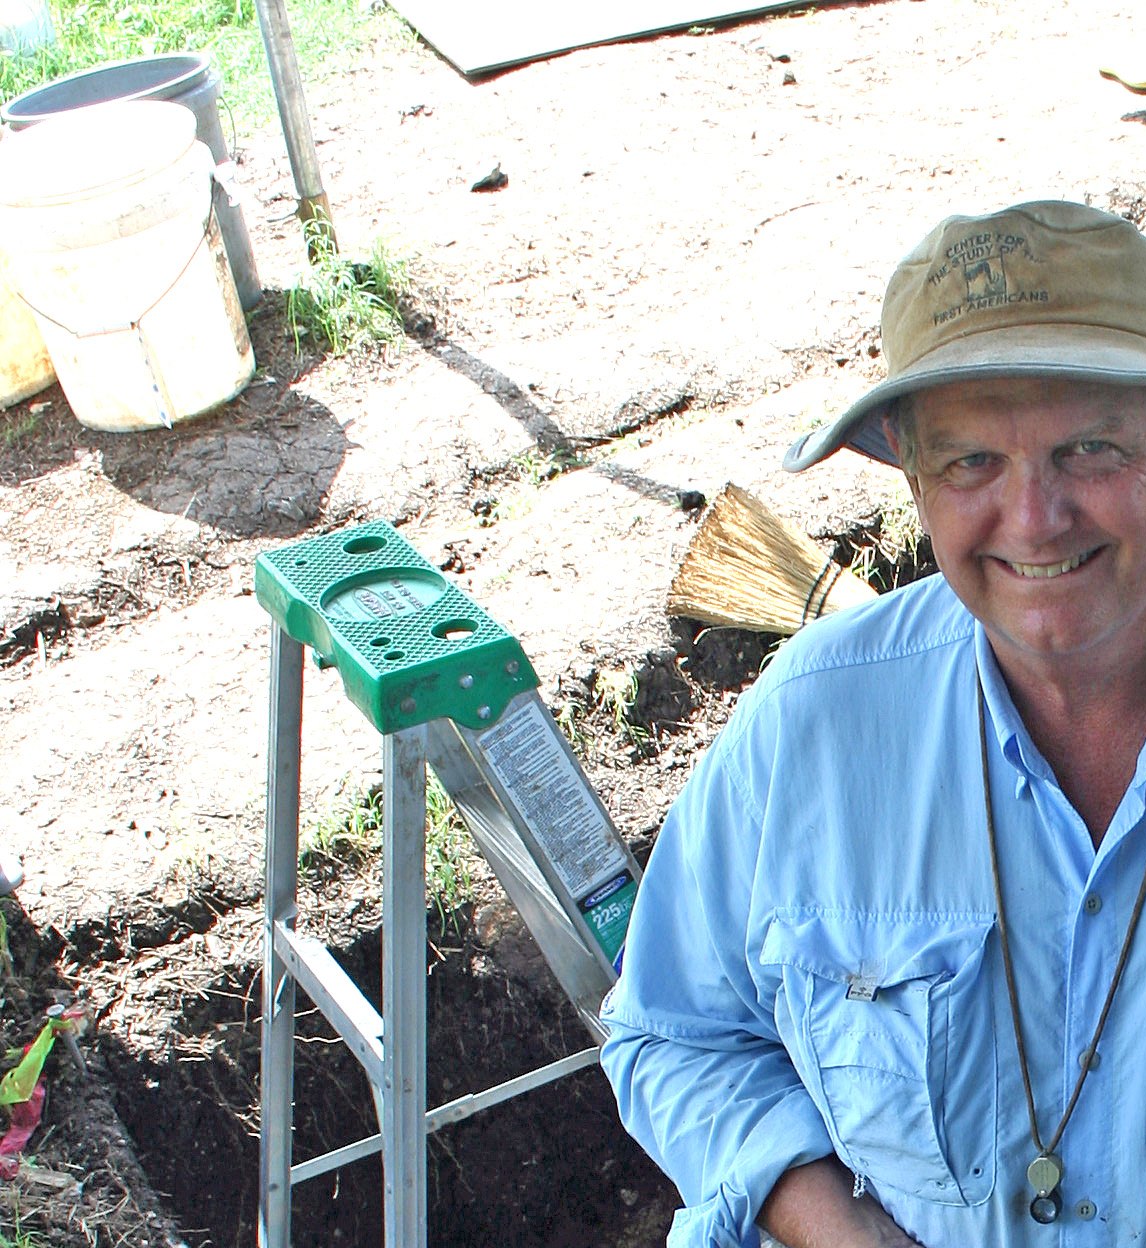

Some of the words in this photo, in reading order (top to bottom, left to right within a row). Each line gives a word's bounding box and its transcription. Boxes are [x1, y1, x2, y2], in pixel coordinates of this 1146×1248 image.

[945, 233, 992, 259] CENTER
[951, 243, 993, 268] STUDY
[933, 305, 962, 326] FIRST
[966, 290, 1049, 313] AMERICANS
[592, 902, 621, 930] 225
